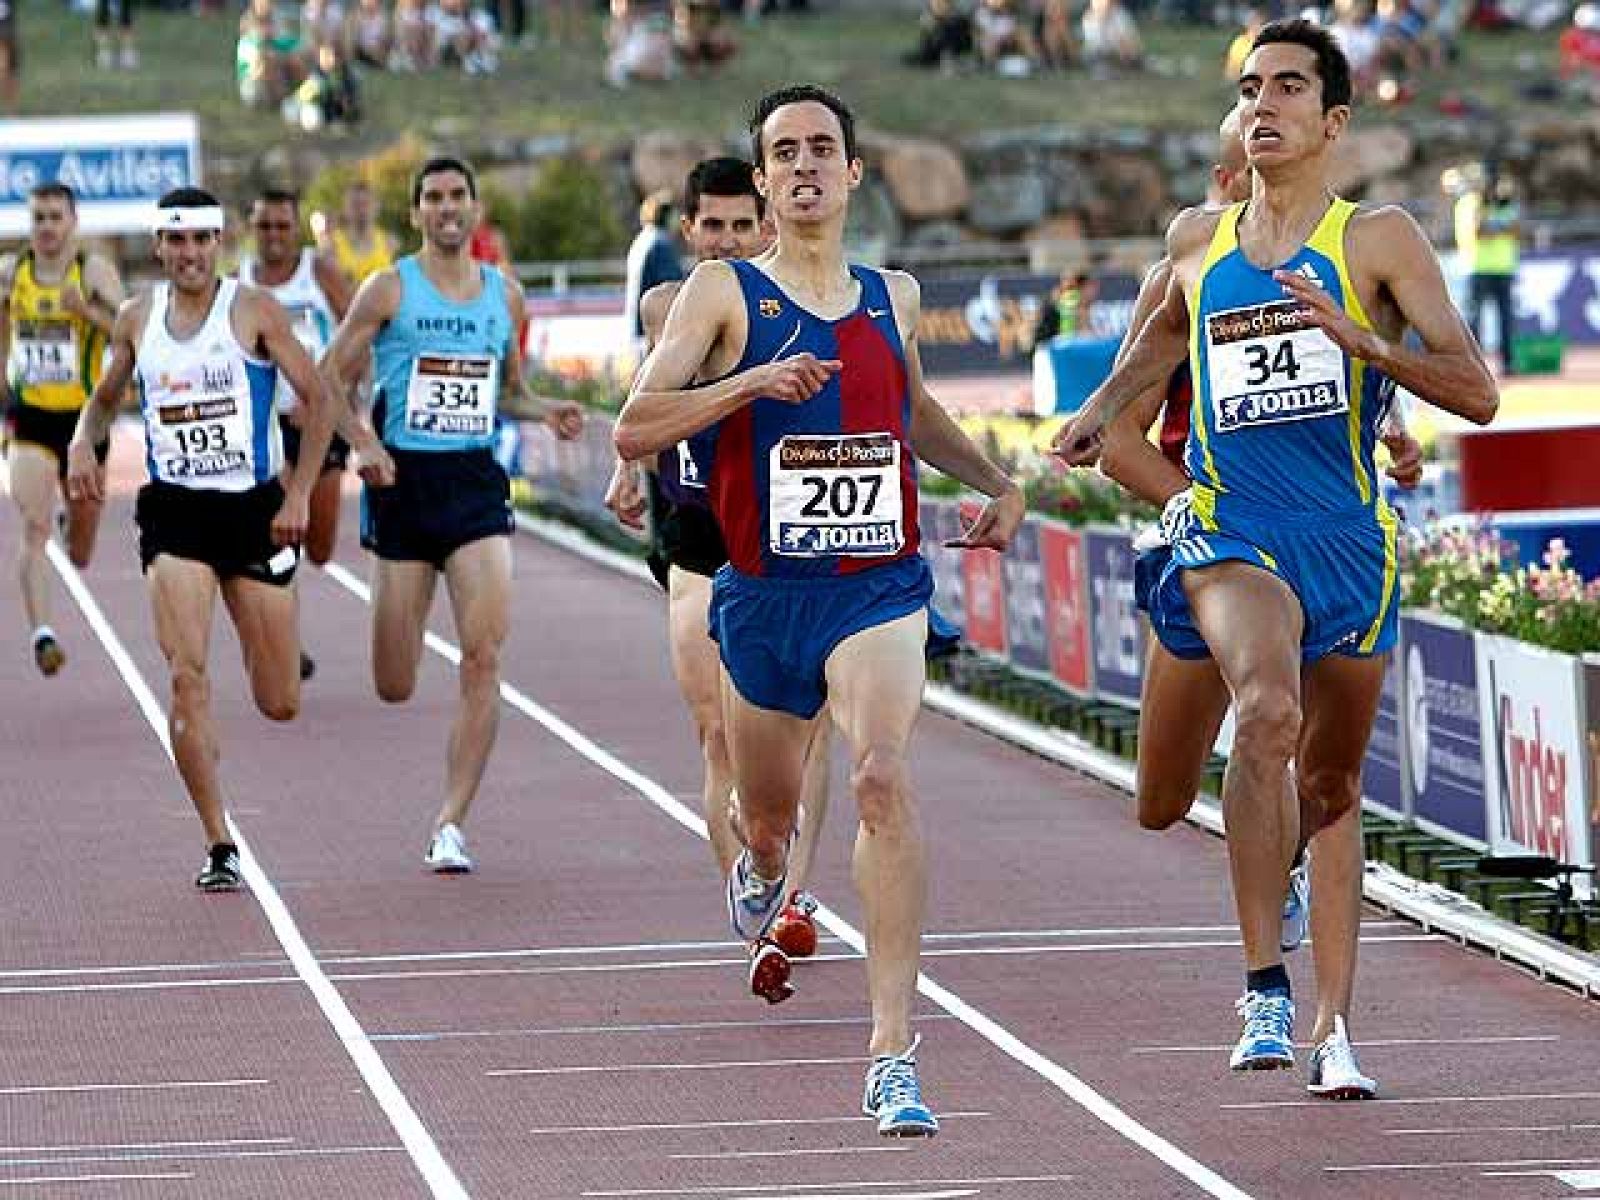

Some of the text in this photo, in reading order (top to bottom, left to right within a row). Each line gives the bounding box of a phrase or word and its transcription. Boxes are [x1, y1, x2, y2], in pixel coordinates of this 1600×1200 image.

[416, 317, 476, 336] nerja
[1244, 339, 1301, 386] 34
[427, 380, 479, 410] 334
[174, 424, 228, 453] 193
[800, 474, 882, 518] 207
